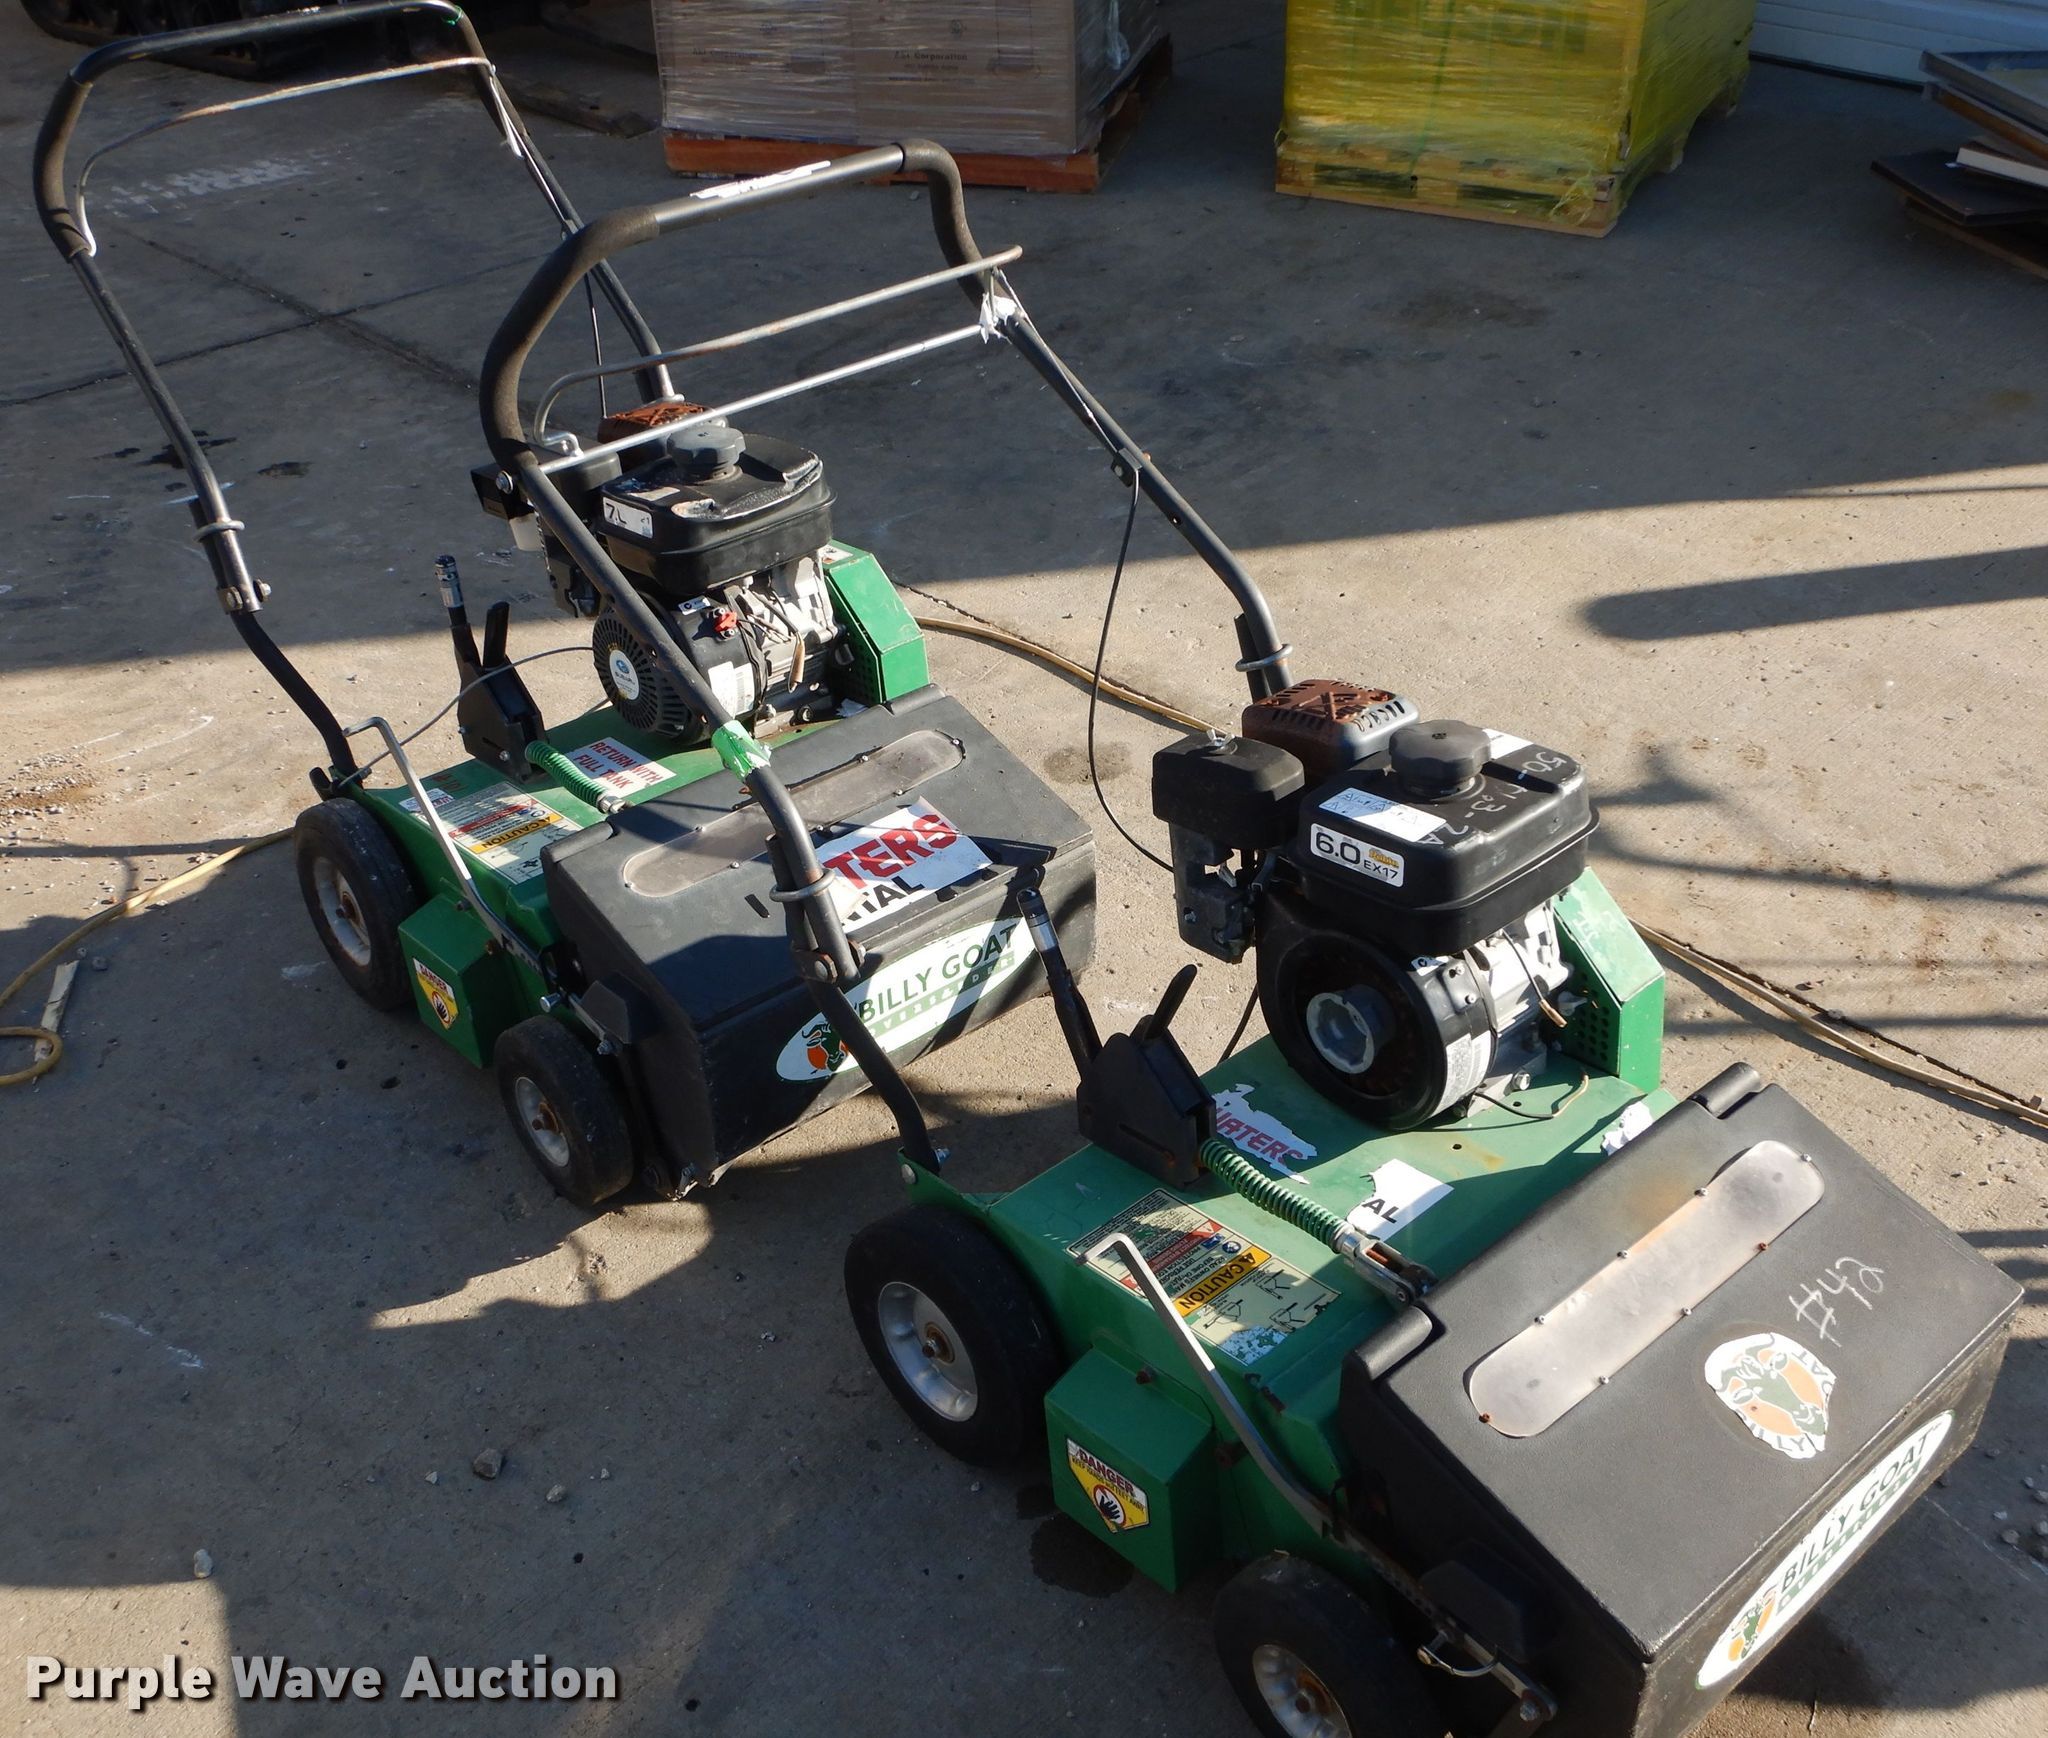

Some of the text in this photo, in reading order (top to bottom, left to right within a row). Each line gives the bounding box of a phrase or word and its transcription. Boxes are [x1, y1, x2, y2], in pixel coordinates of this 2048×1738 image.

[573, 754, 633, 789] FULL TANK
[590, 742, 664, 783] RETURN WITH
[482, 822, 540, 848] CAUTION
[1315, 832, 1361, 865] 6.0
[1363, 859, 1398, 879] EX17
[858, 923, 1017, 1024] BILLY GOAT
[1178, 1263, 1244, 1310] CAUTION
[1787, 1256, 1885, 1347] #42
[1075, 1448, 1136, 1497] DANGER
[1781, 1503, 1855, 1592] BILLY
[1859, 1428, 1932, 1511] GOAT
